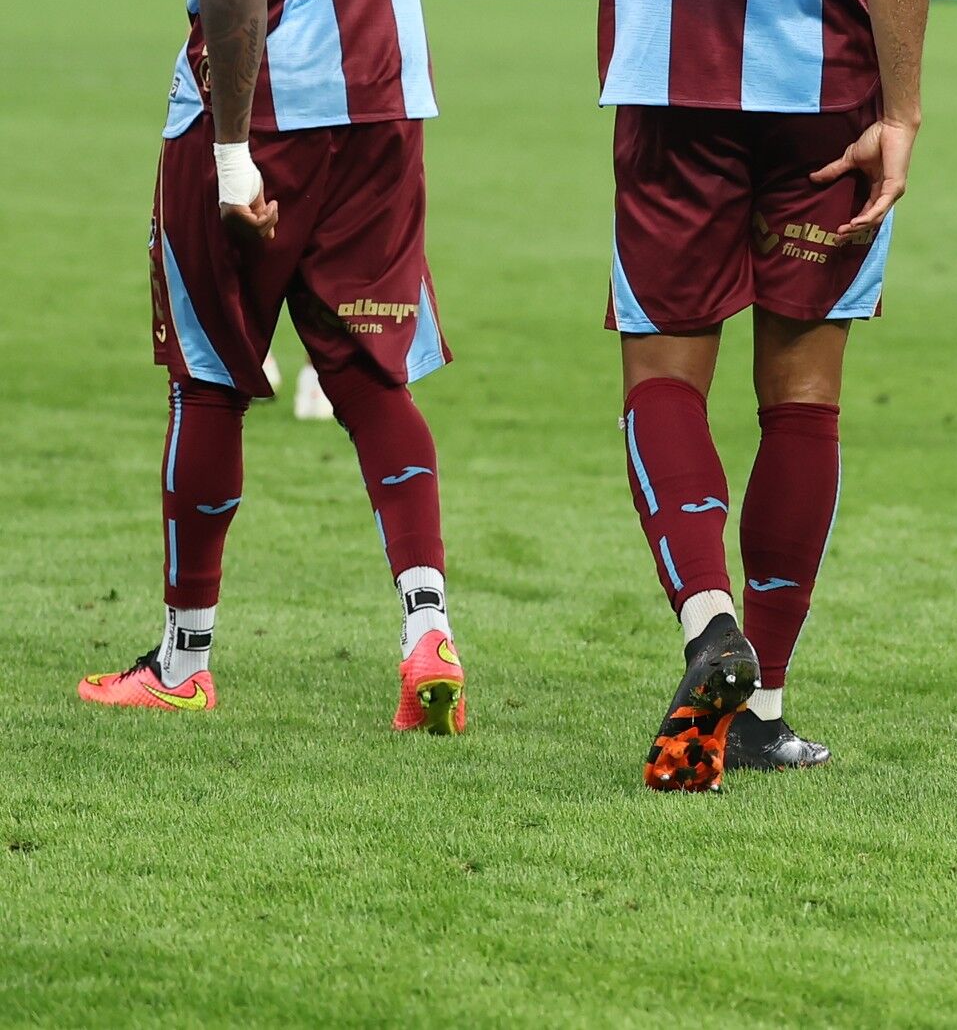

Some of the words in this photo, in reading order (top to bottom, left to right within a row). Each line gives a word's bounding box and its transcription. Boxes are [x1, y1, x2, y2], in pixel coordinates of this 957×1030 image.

[782, 243, 827, 264] finans
[338, 299, 418, 324] albayr
[344, 321, 383, 334] inans
